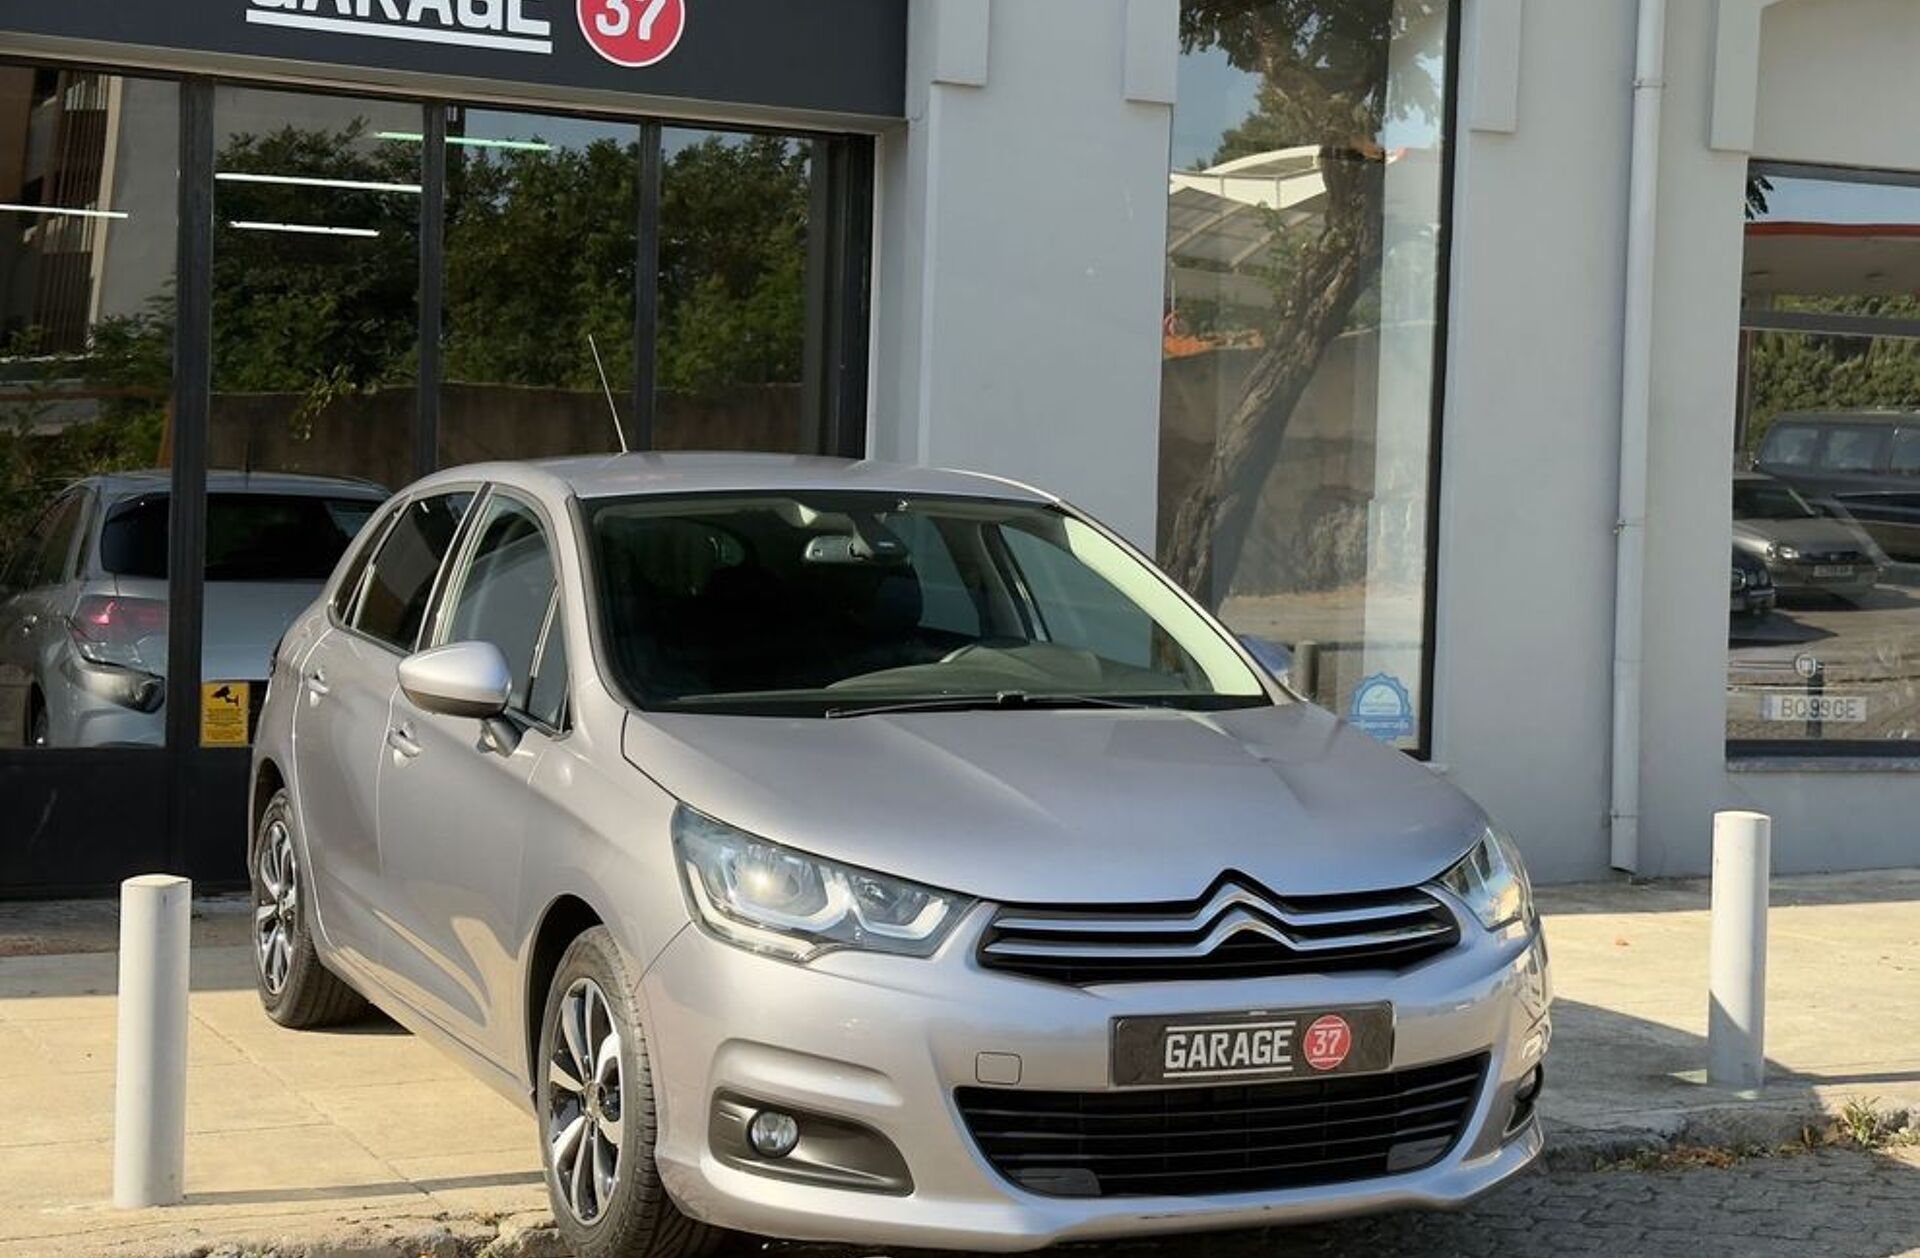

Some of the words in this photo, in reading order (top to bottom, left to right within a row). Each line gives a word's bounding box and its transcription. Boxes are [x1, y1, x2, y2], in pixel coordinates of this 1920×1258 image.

[595, 0, 666, 41] 37
[1164, 1029, 1294, 1070] GARAGE
[1312, 1028, 1343, 1057] 37
